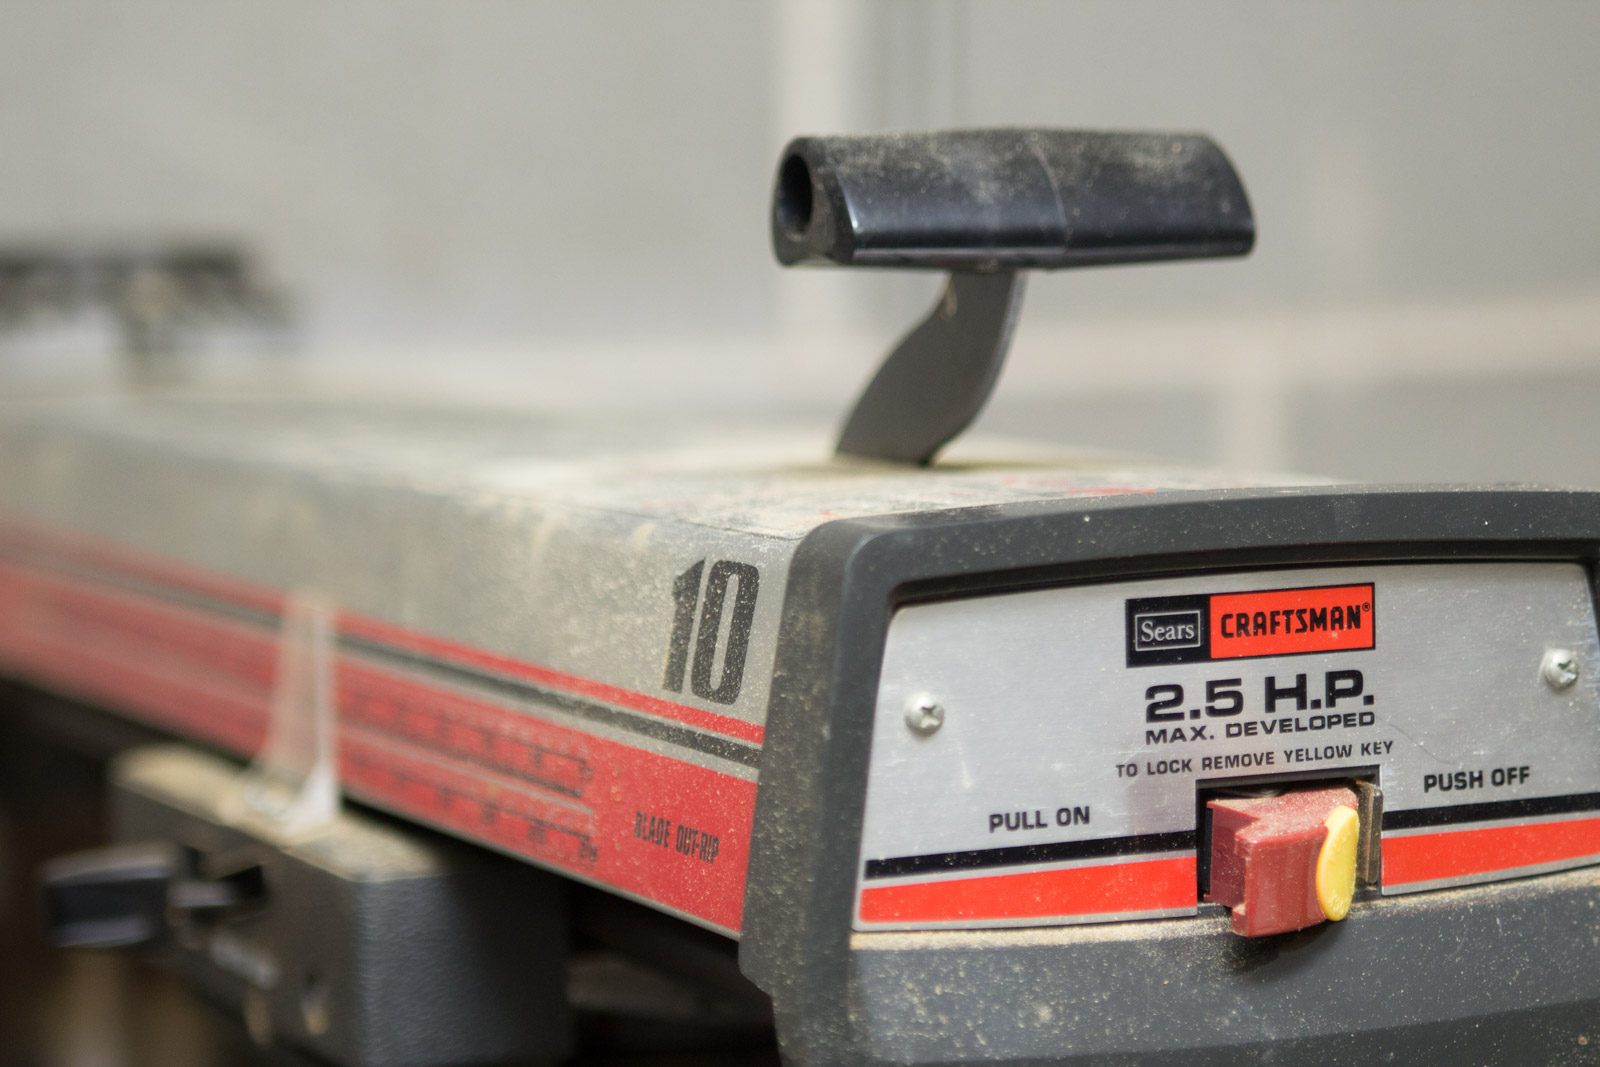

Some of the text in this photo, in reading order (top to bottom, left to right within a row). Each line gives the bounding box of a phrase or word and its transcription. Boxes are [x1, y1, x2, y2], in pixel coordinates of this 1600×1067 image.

[662, 557, 760, 705] 10
[1141, 620, 1195, 642] Sears
[1145, 669, 1375, 724] 2.5 H.P.
[1145, 711, 1375, 745] MAX. DEVELOPED
[1115, 740, 1394, 778] TO LOCK REMOVE YELLOW KEY
[1423, 765, 1530, 793] PUSH OFF
[633, 810, 671, 848] BLADE
[989, 805, 1090, 834] PULL ON
